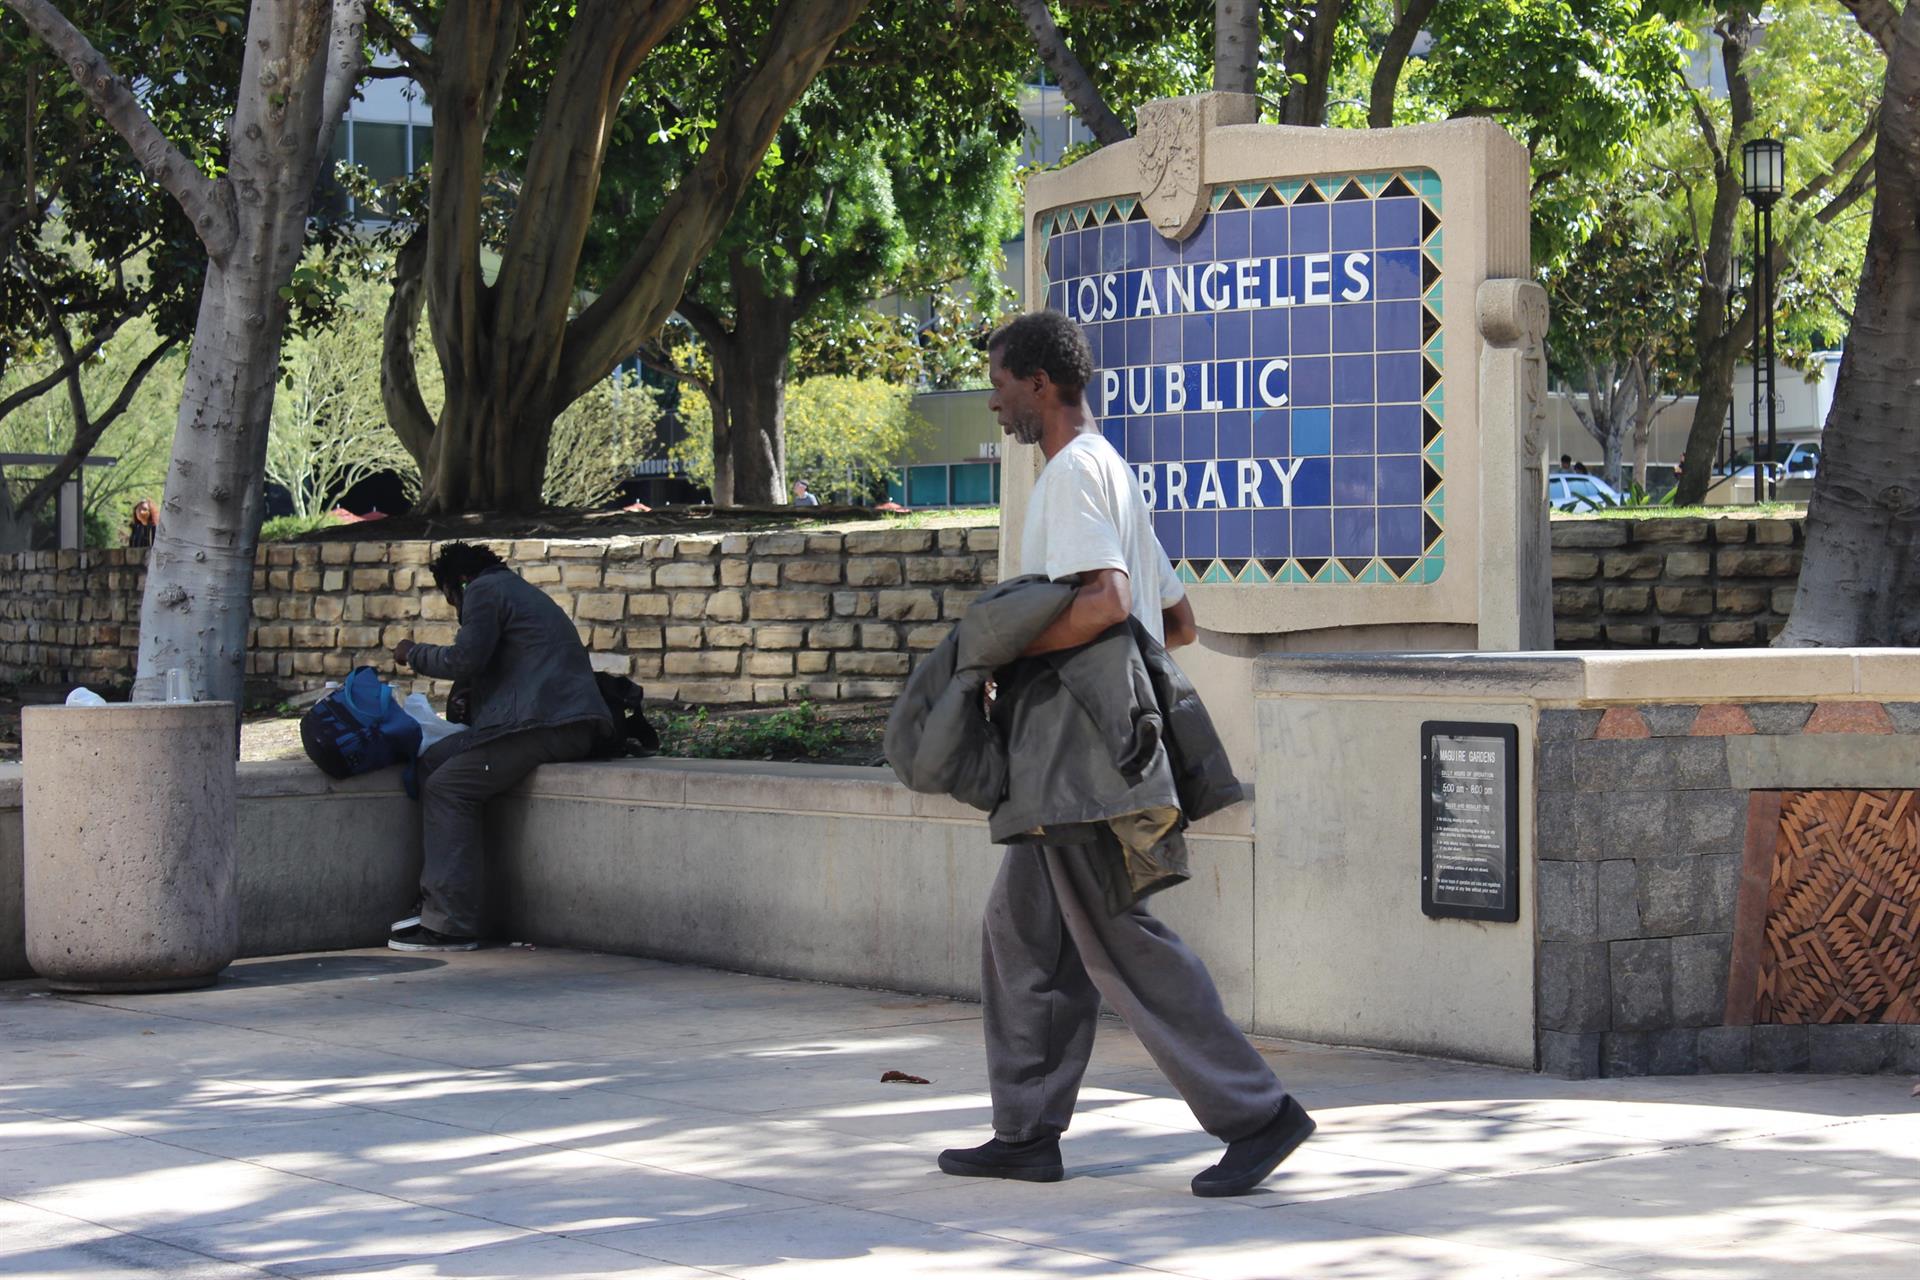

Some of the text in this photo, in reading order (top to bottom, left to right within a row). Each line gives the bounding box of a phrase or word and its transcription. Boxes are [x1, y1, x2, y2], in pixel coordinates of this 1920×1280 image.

[1064, 252, 1371, 323] LOS ANGELES
[1103, 358, 1290, 418] PUBLIC
[1138, 457, 1305, 511] BRARY
[1440, 749, 1496, 764] MAGUIRE GARDENS
